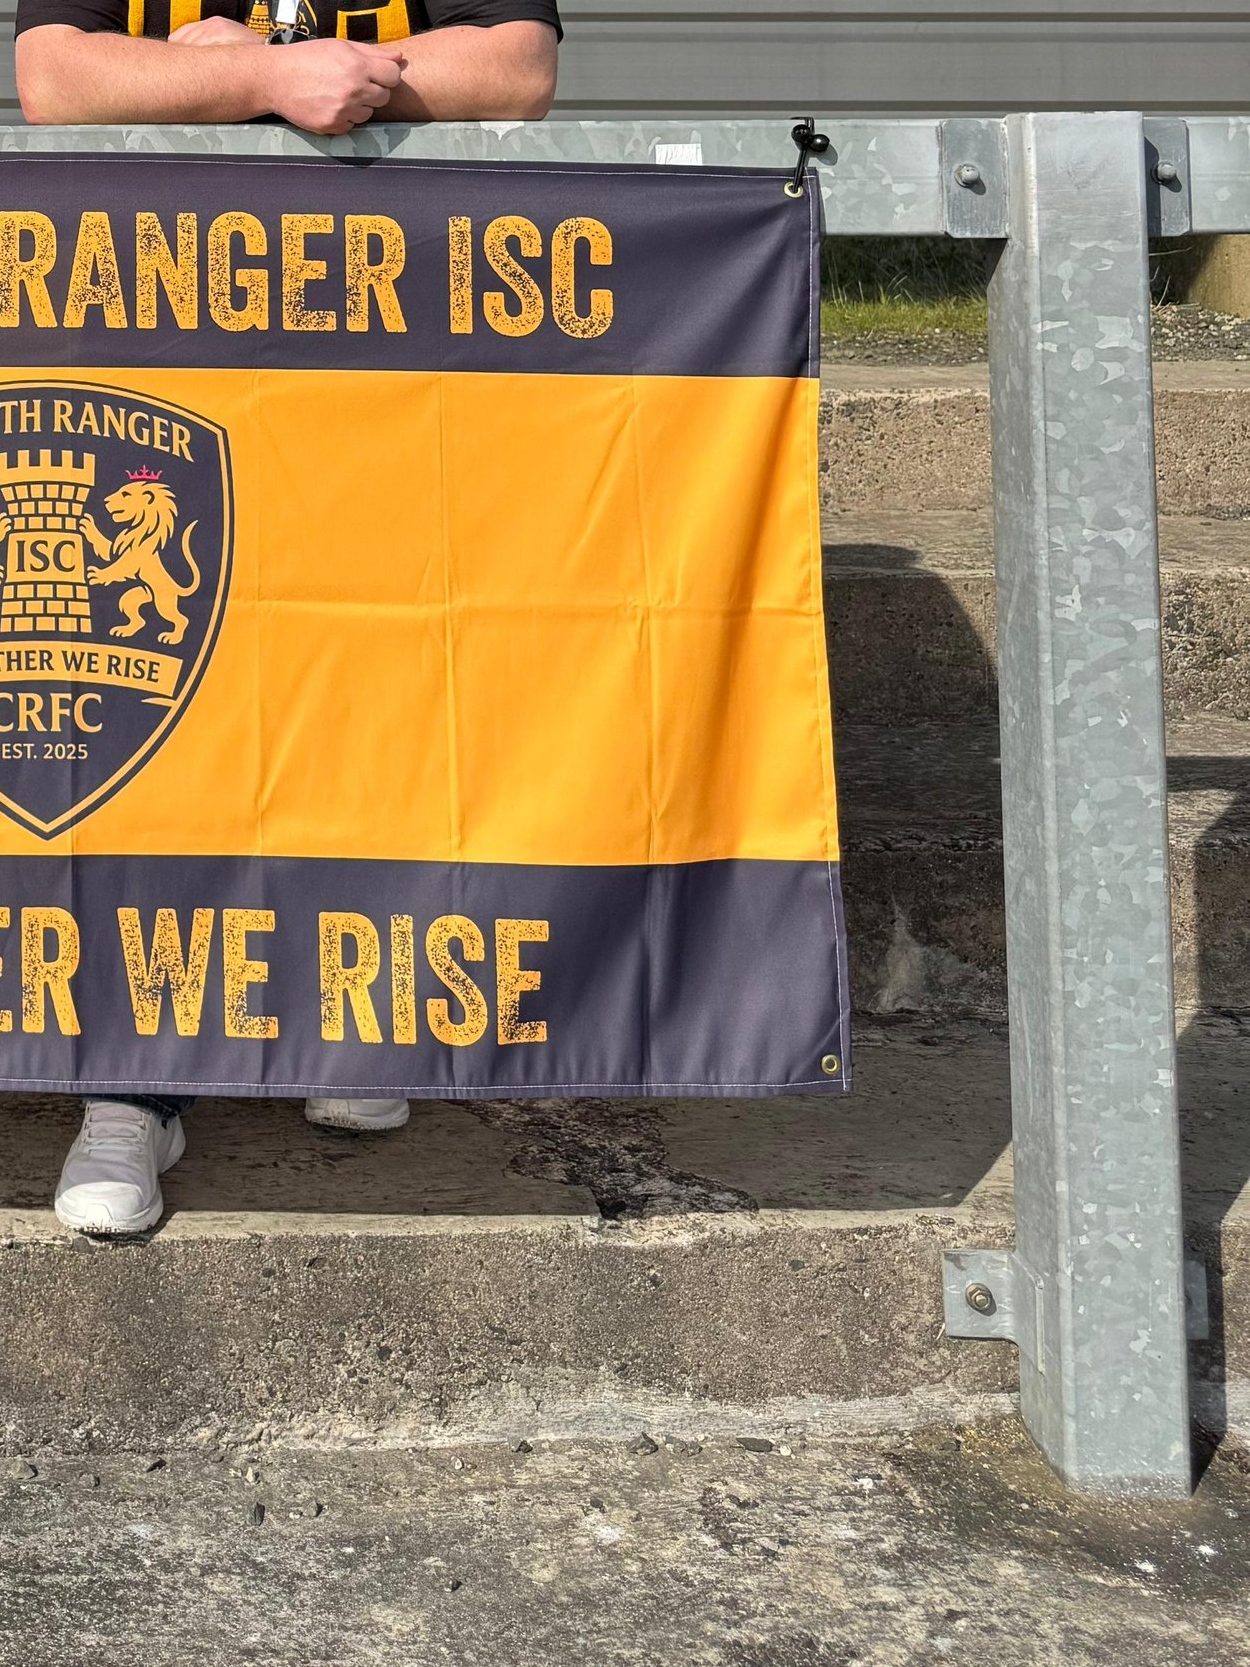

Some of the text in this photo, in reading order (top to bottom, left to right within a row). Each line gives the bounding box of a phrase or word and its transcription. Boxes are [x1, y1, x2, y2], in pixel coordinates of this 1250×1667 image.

[448, 215, 614, 339] ISC
[54, 399, 194, 463] RANGER
[16, 539, 77, 573] ISC
[62, 650, 99, 674] WE
[107, 655, 161, 683] RISE
[2, 743, 89, 760] EST. 2025
[116, 907, 279, 1039] WE
[318, 910, 549, 1047] RISE
